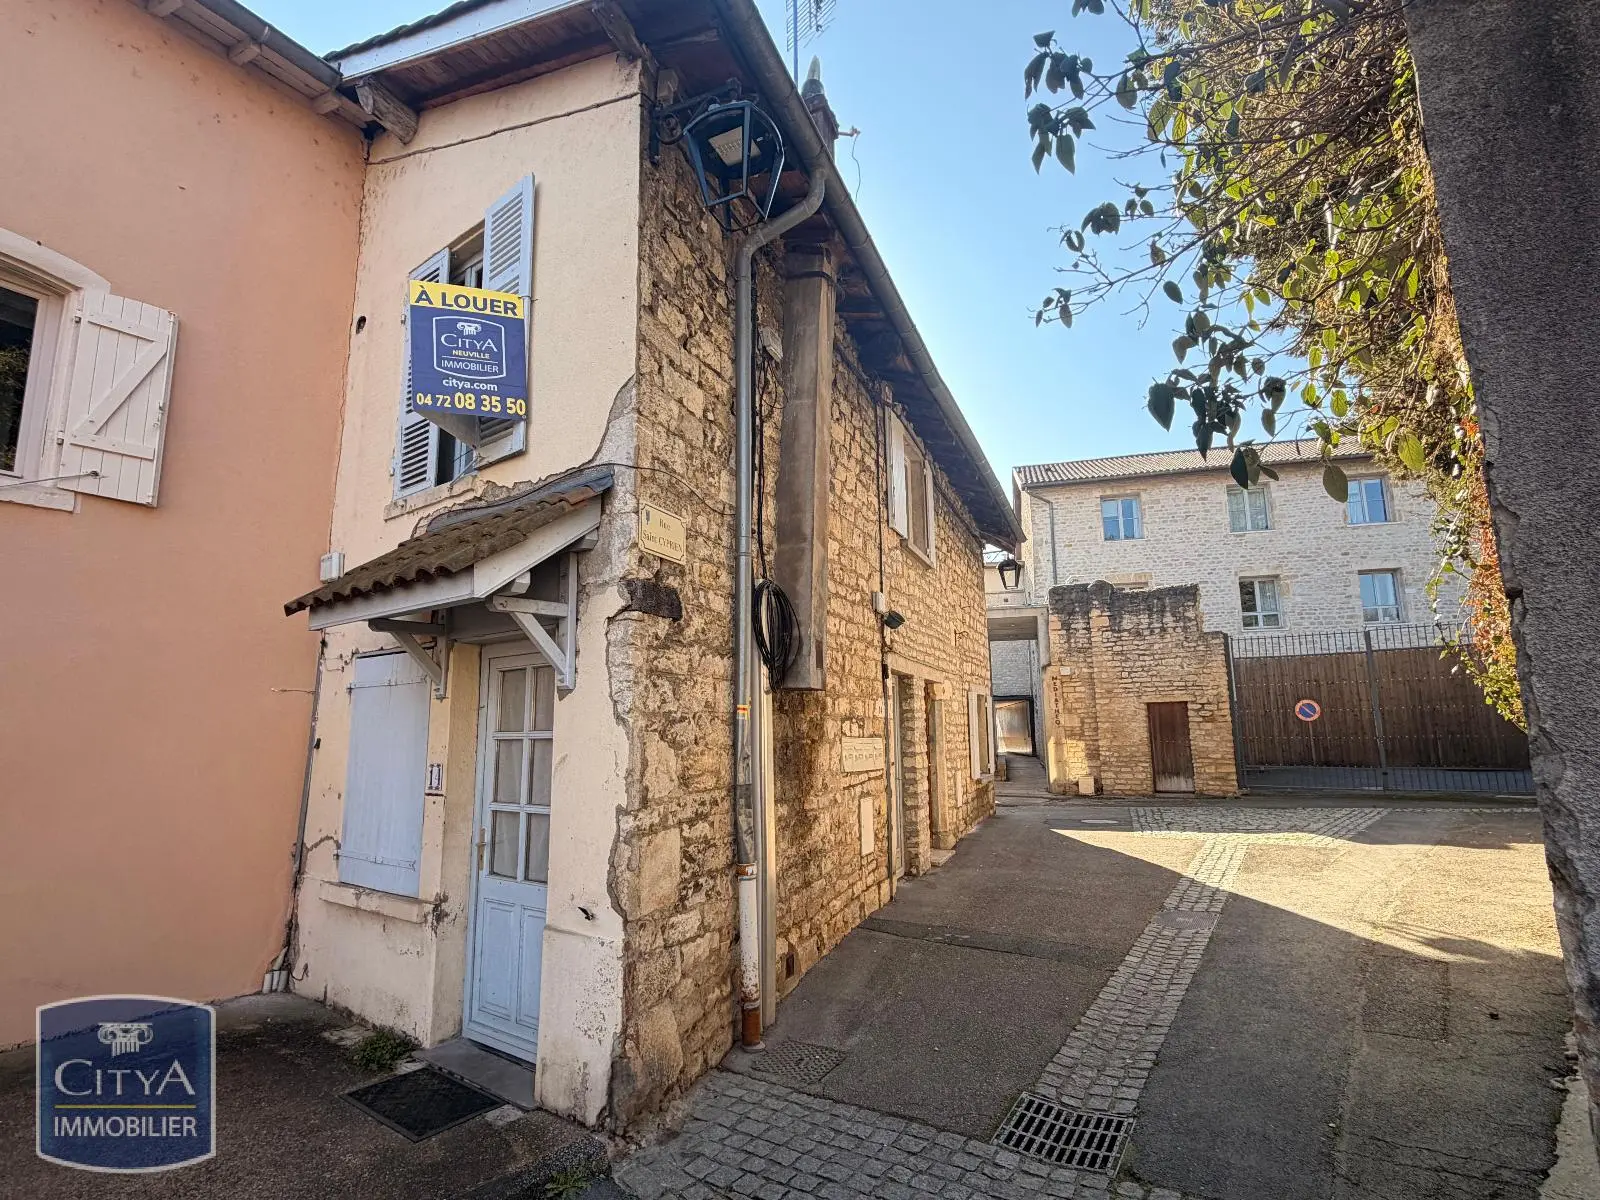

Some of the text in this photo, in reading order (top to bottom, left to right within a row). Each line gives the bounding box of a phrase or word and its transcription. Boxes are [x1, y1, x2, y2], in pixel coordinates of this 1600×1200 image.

[414, 284, 518, 317] À LOUER
[452, 349, 490, 360] NEUVILLE
[441, 359, 499, 374] IMMOBILIER
[442, 377, 498, 392] citya.com
[416, 392, 526, 416] 04 72 08 35 50
